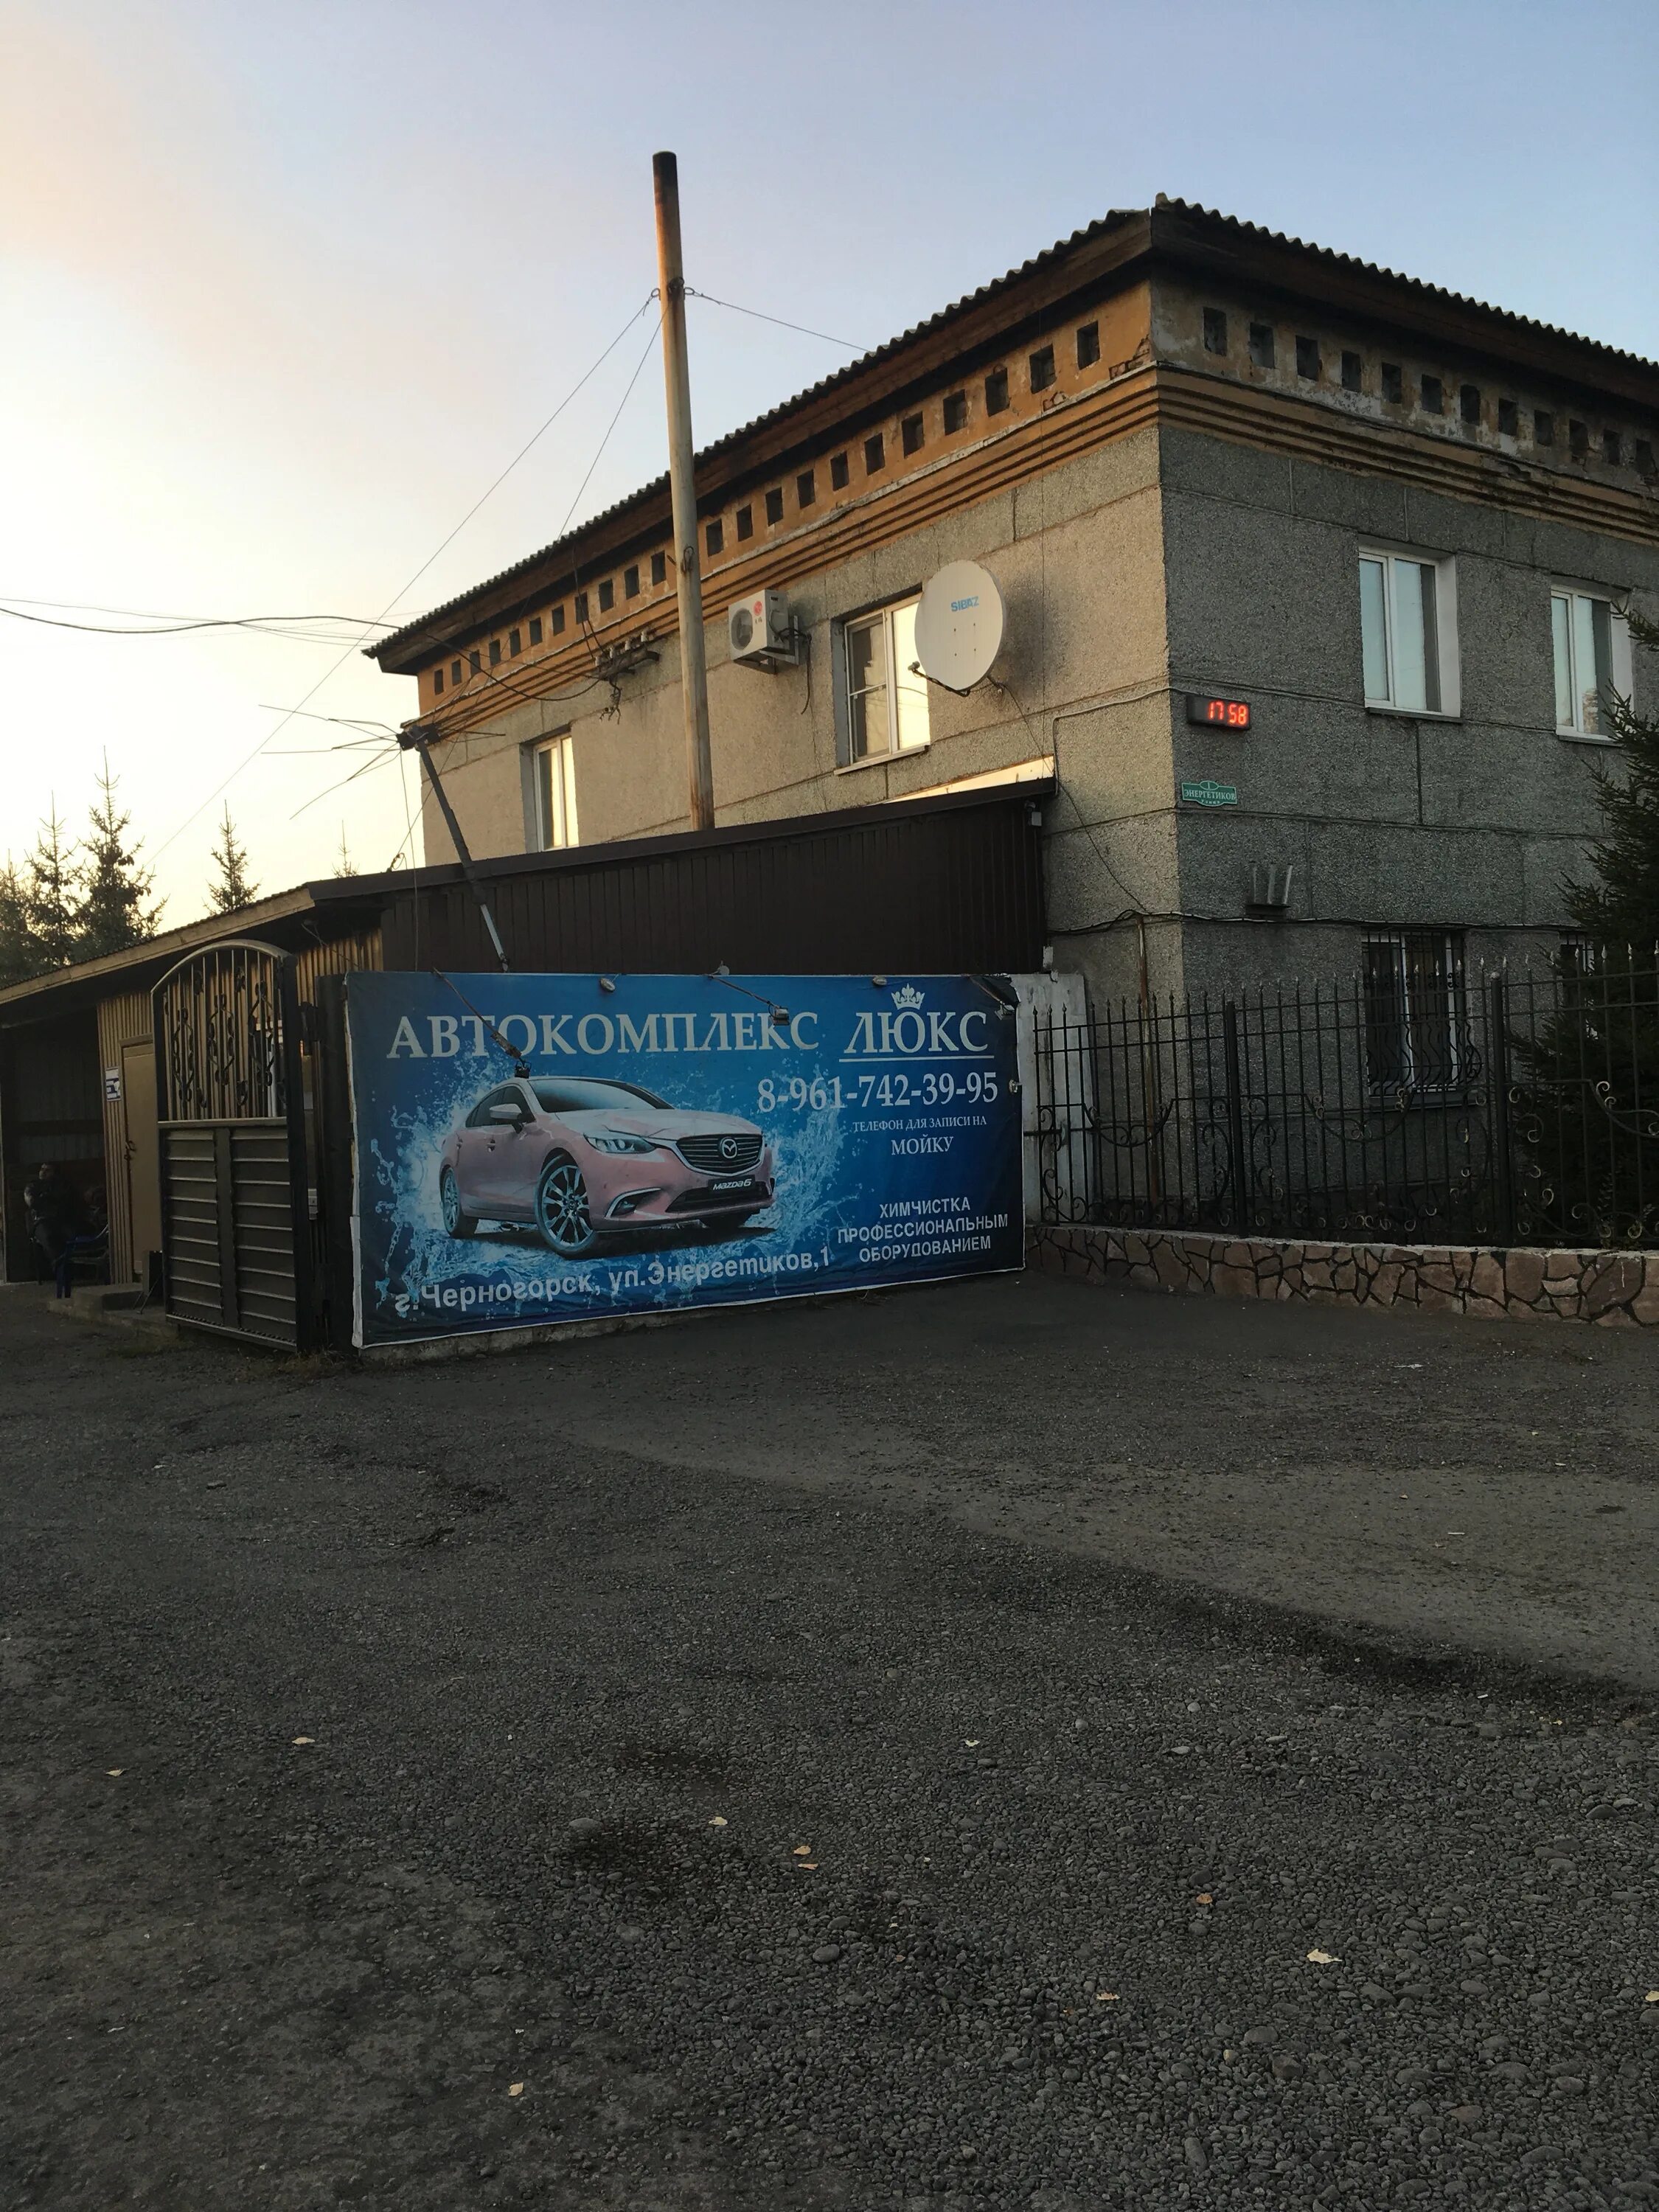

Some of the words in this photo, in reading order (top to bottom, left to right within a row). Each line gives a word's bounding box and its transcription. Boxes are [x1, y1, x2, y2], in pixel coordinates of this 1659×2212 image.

[1183, 789, 1236, 800] ЭНЕРГЕТИКОВ
[386, 1012, 819, 1059] АВТОКОМПЛЕКС
[844, 1011, 988, 1054] ЛЮКС
[757, 1071, 998, 1113] 8-961-742-39-95
[852, 1119, 903, 1133] ТЕЛЕФОН
[905, 1119, 927, 1131] ДЛЯ
[929, 1116, 970, 1128] ЗАПИСИ
[973, 1116, 987, 1126] НА
[891, 1134, 954, 1155] МОЙКУ
[880, 1197, 970, 1218] ХИМЧИСТКА
[838, 1214, 1008, 1244] ПРОФЕССИОНАЛЬНЫМ
[859, 1235, 991, 1262] ОБОРУДОВАНИЕМ
